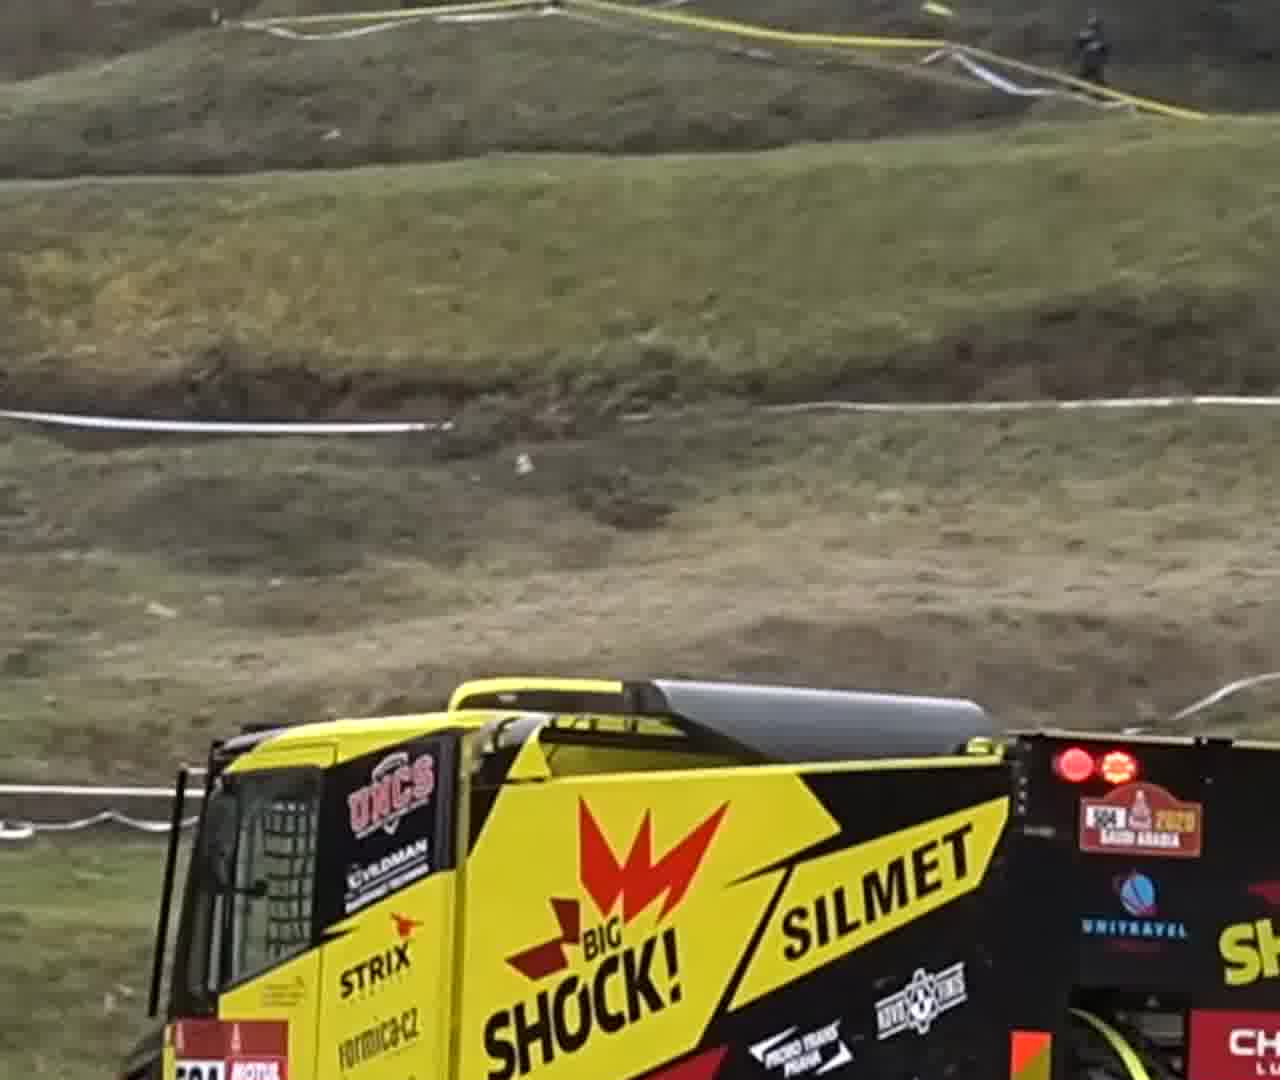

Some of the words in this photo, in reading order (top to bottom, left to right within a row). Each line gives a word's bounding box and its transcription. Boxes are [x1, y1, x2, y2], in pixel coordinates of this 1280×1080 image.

[782, 822, 974, 961] SILMET
[582, 915, 622, 962] BIG
[1081, 917, 1189, 939] UNITRAVEL
[340, 942, 411, 999] STRIX
